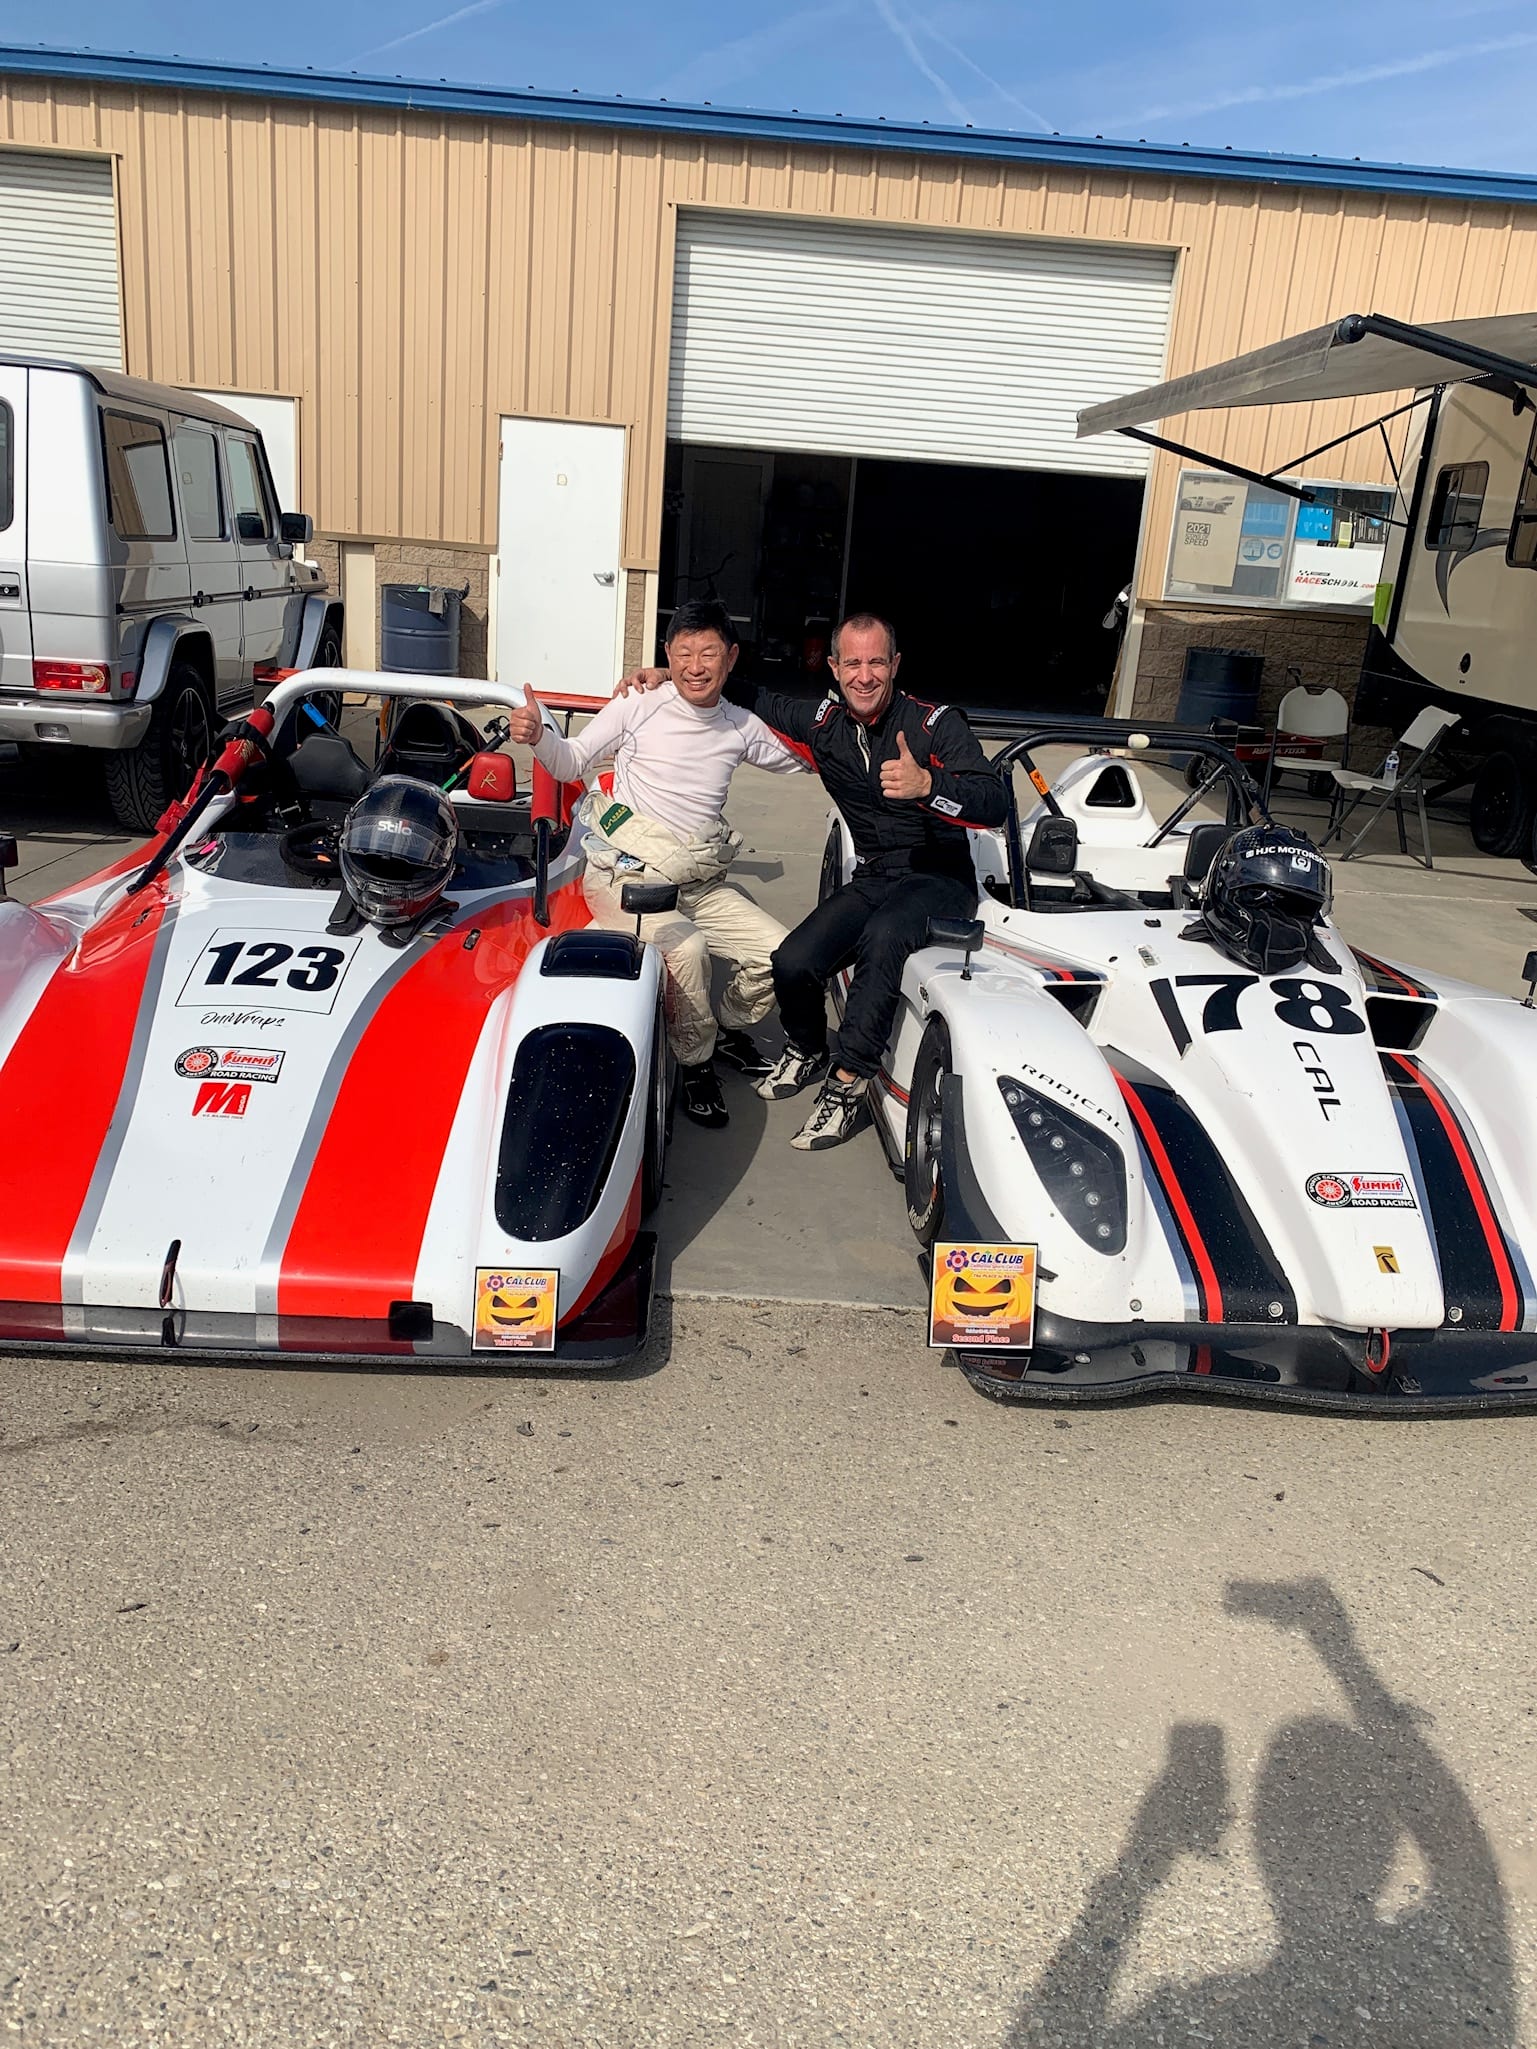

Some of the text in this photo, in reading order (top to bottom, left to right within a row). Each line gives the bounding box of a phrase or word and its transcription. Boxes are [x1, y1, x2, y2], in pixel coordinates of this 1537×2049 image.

[1187, 522, 1210, 534] 2021
[1183, 537, 1209, 547] SPEED
[1255, 846, 1276, 855] HJC
[203, 941, 346, 992] 123
[238, 1072, 276, 1081] RACING
[1292, 1041, 1342, 1122] CAL
[1021, 1063, 1125, 1136] RADICAL
[1352, 1199, 1379, 1207] ROAD
[952, 1334, 1011, 1344] Second Place
